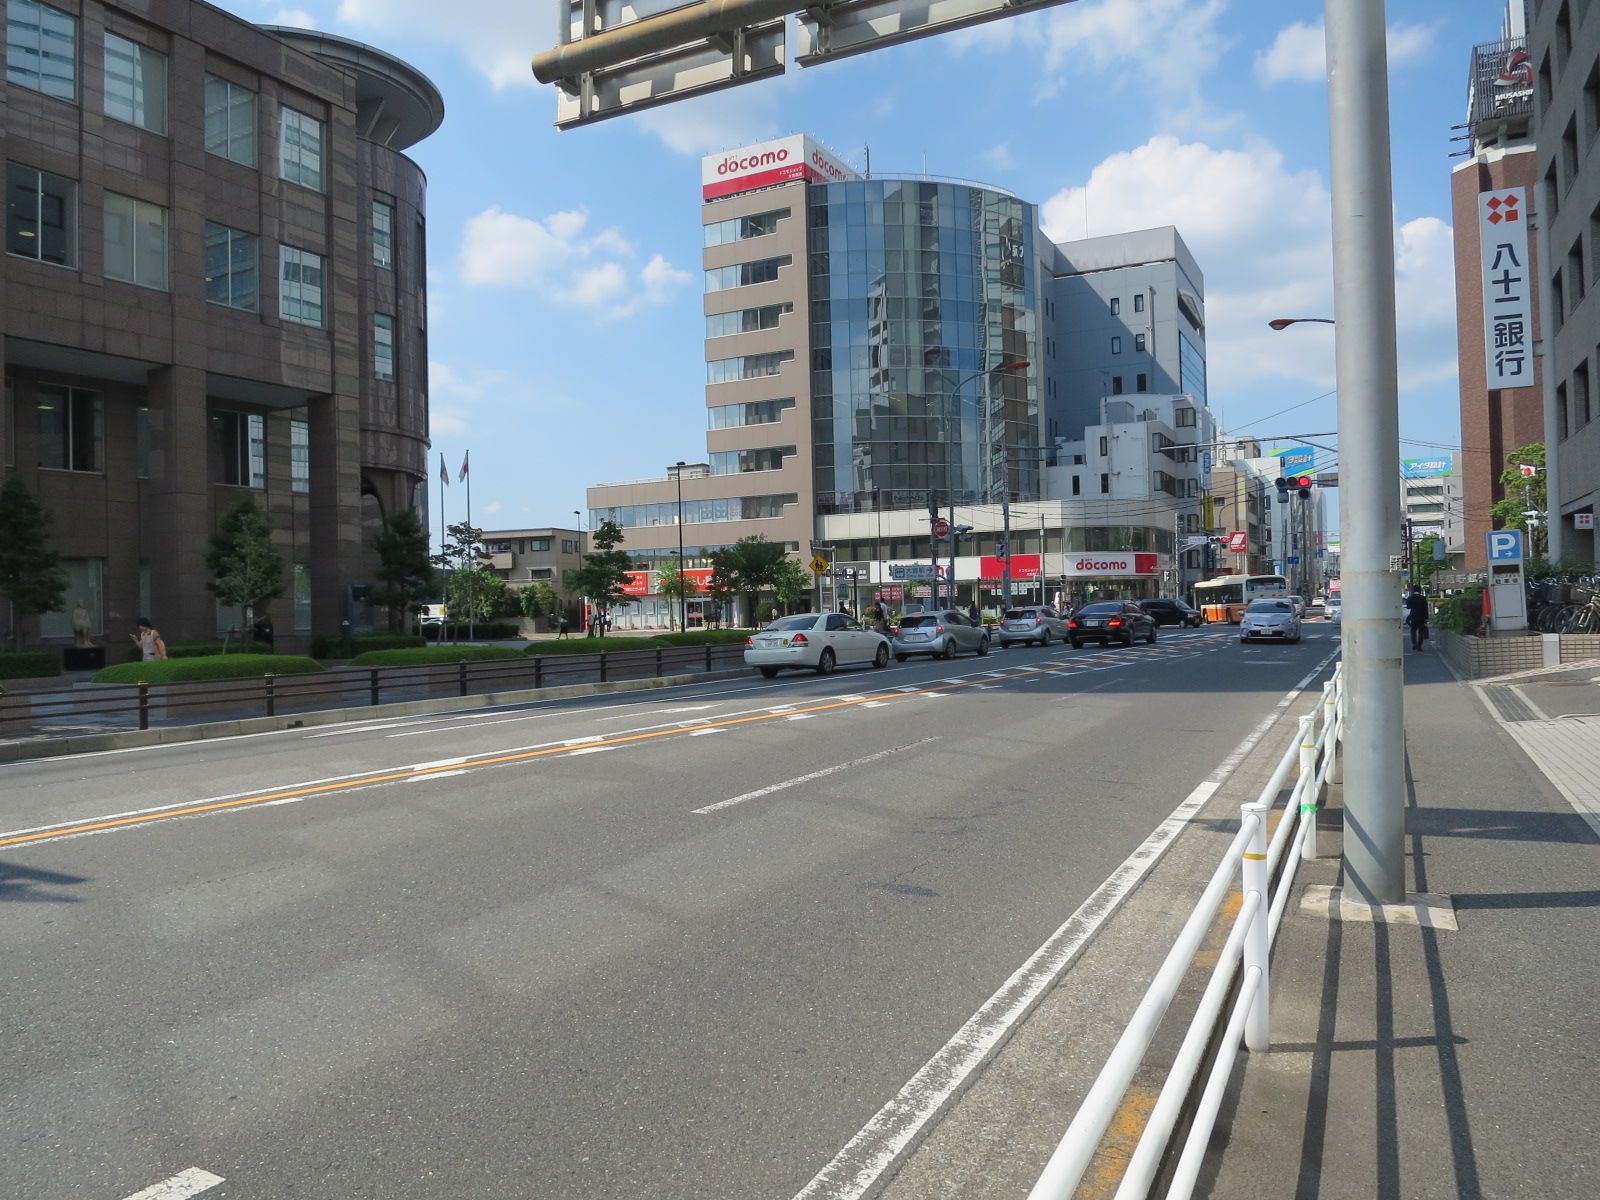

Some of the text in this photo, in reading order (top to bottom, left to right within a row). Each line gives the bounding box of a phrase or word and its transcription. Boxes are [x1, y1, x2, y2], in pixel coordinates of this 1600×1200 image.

[717, 148, 788, 175] docomo
[1491, 243, 1524, 376] 八十二銀行
[1492, 535, 1516, 558] P
[1076, 558, 1127, 570] docomo
